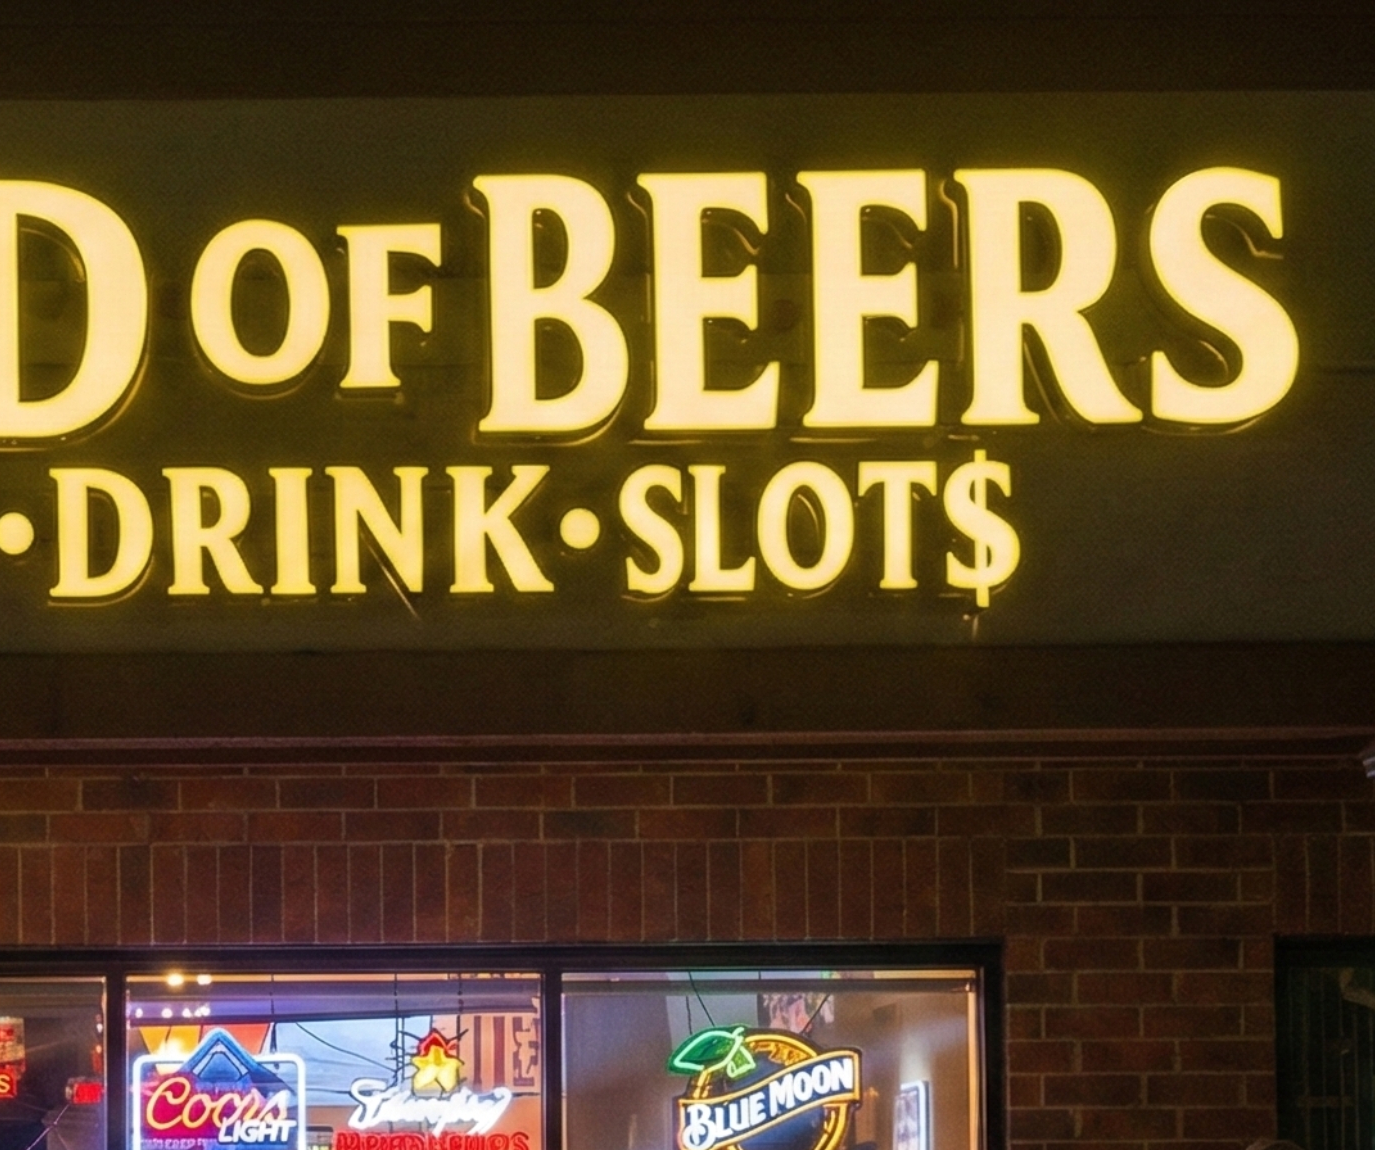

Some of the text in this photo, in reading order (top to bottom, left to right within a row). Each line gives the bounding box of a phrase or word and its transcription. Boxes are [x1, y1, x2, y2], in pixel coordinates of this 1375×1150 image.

[190, 218, 442, 388] OF
[472, 166, 1300, 432] BEERS
[49, 464, 555, 599] DRINK
[218, 1117, 298, 1143] LIGHT
[768, 1057, 854, 1118] MOON
